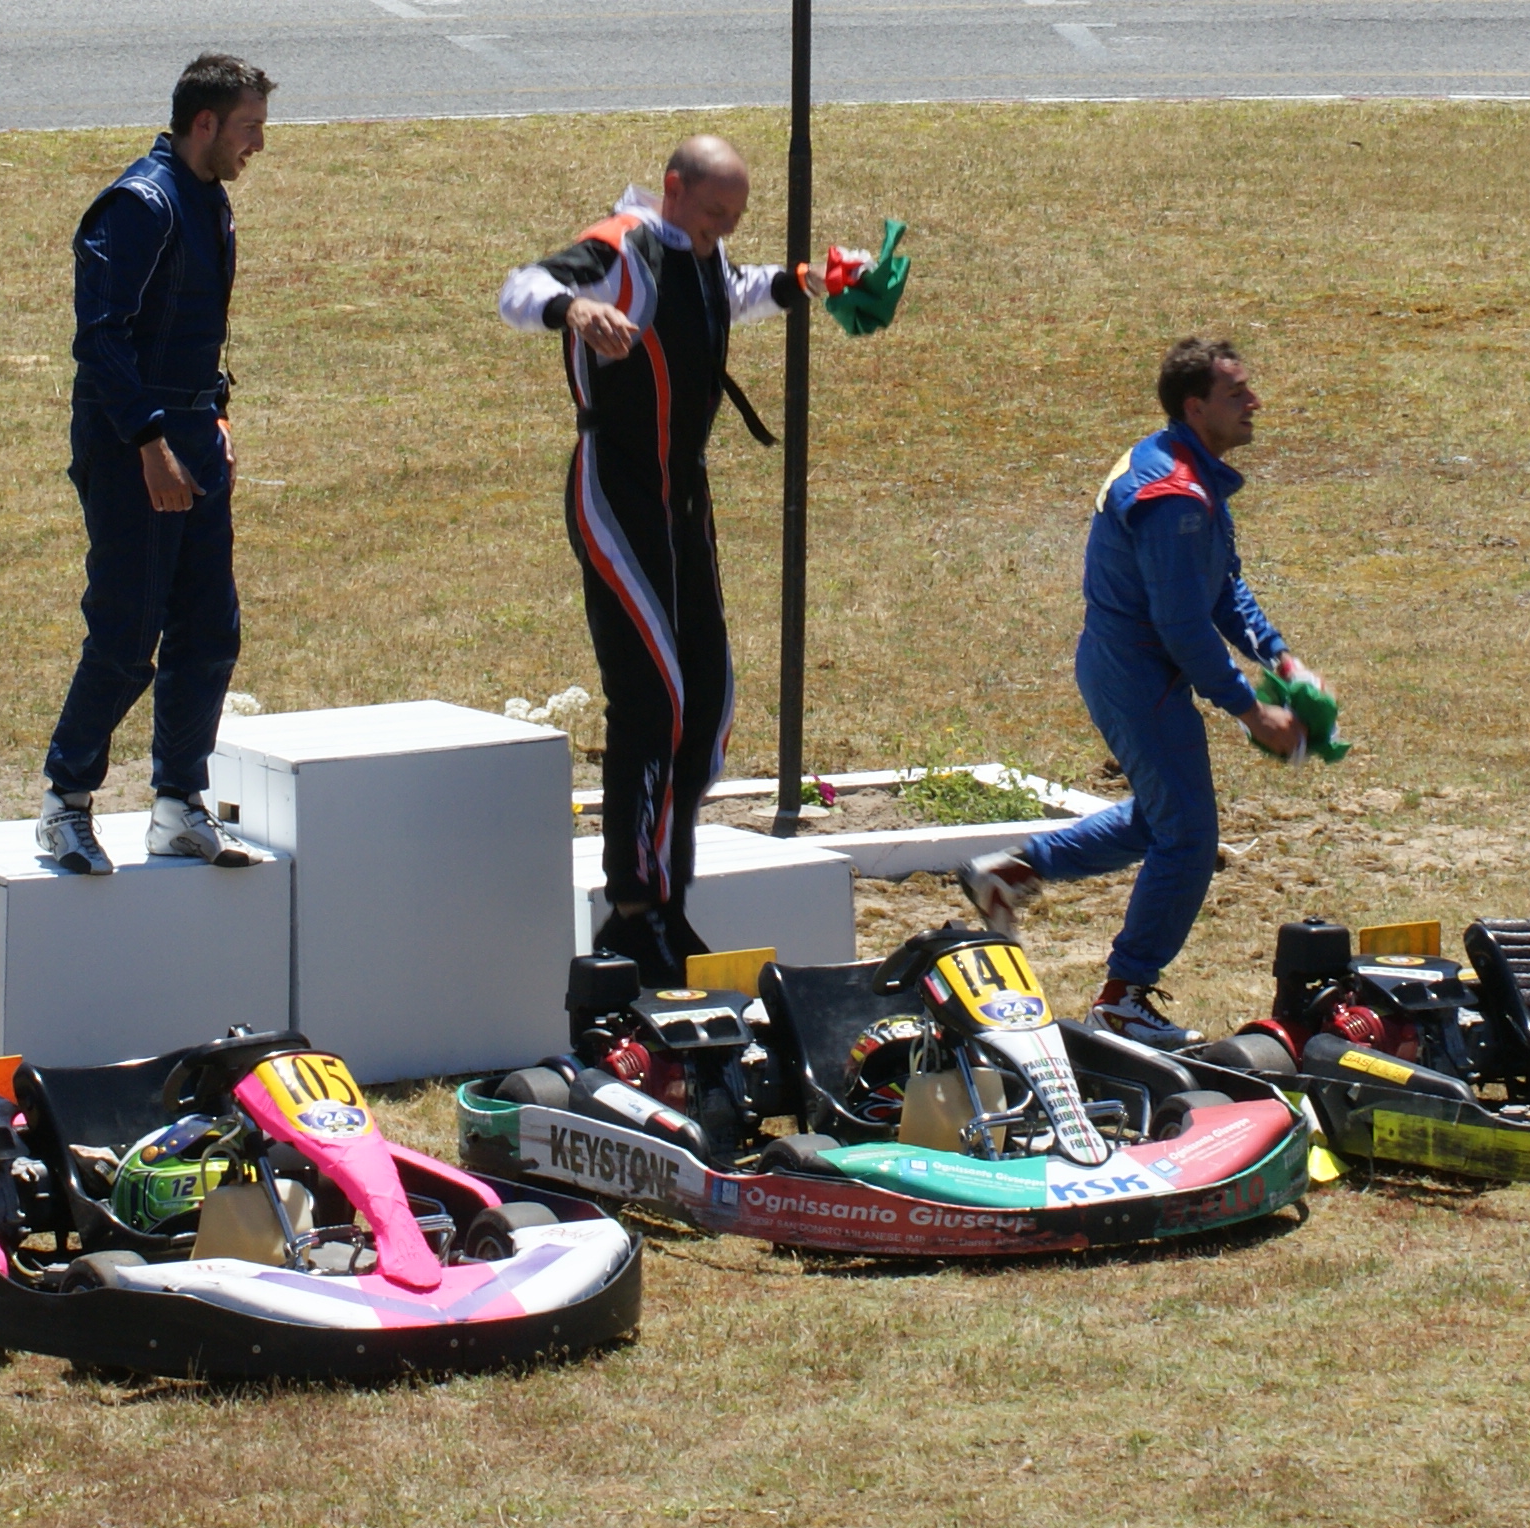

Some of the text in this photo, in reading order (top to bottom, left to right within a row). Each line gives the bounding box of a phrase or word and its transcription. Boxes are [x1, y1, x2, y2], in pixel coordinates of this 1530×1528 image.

[949, 945, 1032, 998] 141
[269, 1056, 358, 1107] 105
[1343, 1053, 1371, 1068] GAS
[172, 1175, 197, 1197] 12
[549, 1124, 681, 1201] KEYSTONE
[745, 1186, 1037, 1234] Ognissanto Giusepp
[1049, 1173, 1150, 1201] KSK
